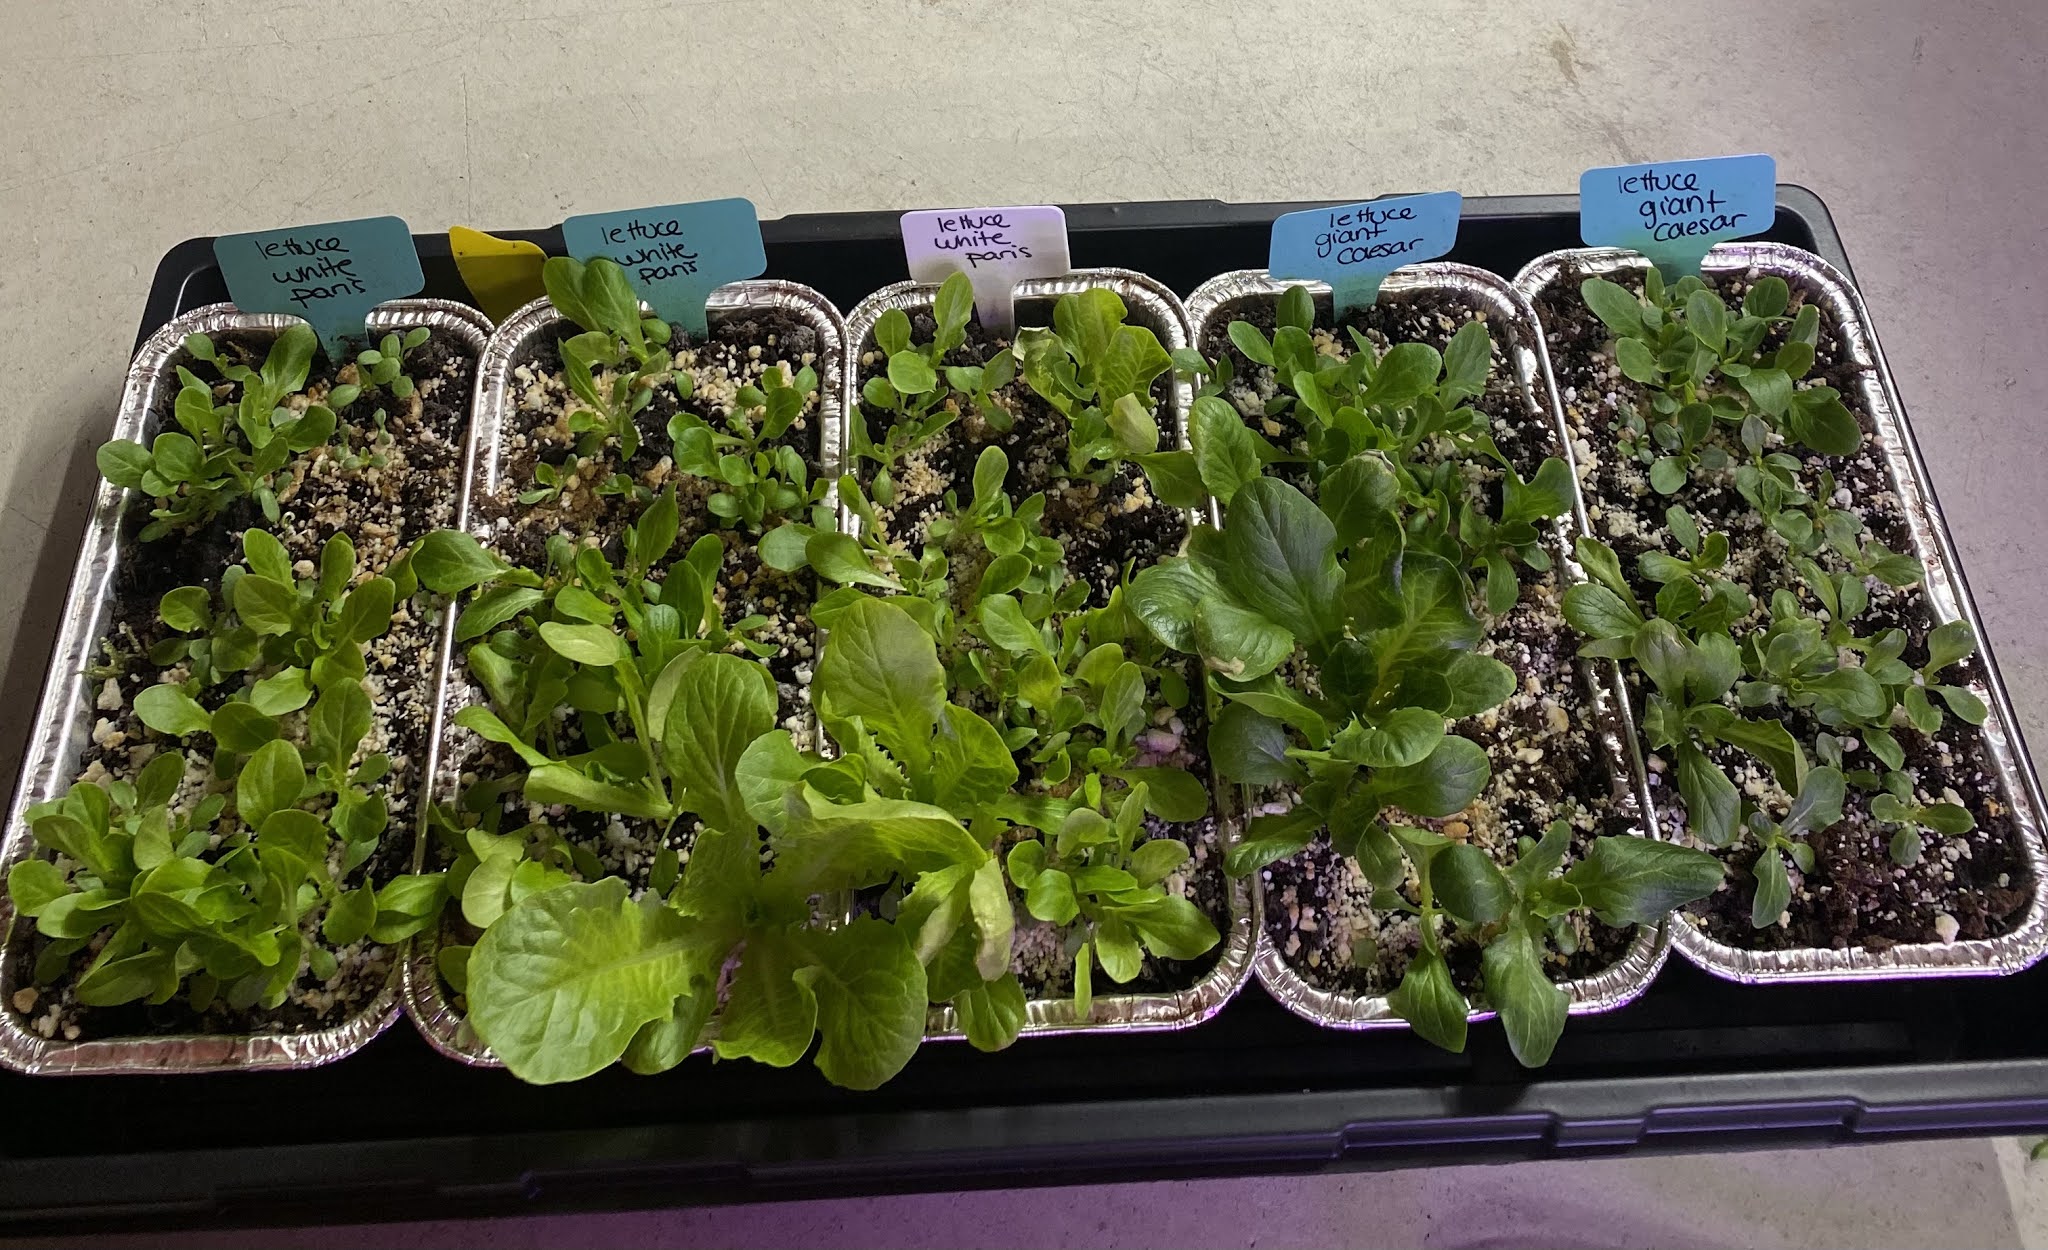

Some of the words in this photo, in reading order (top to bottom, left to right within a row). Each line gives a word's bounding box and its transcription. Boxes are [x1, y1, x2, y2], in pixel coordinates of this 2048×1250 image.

[1617, 169, 1699, 194] lettuce
[1329, 206, 1418, 228] lettuce
[1639, 189, 1727, 230] giant
[601, 219, 684, 245] lettuce
[937, 213, 1011, 233] lettuce
[1653, 213, 1748, 242] caesar
[254, 237, 350, 260] lettuce
[934, 230, 1012, 250] white
[1314, 223, 1387, 258] giant
[1336, 237, 1424, 265] caesar
[614, 242, 698, 266] white
[272, 256, 357, 284] white
